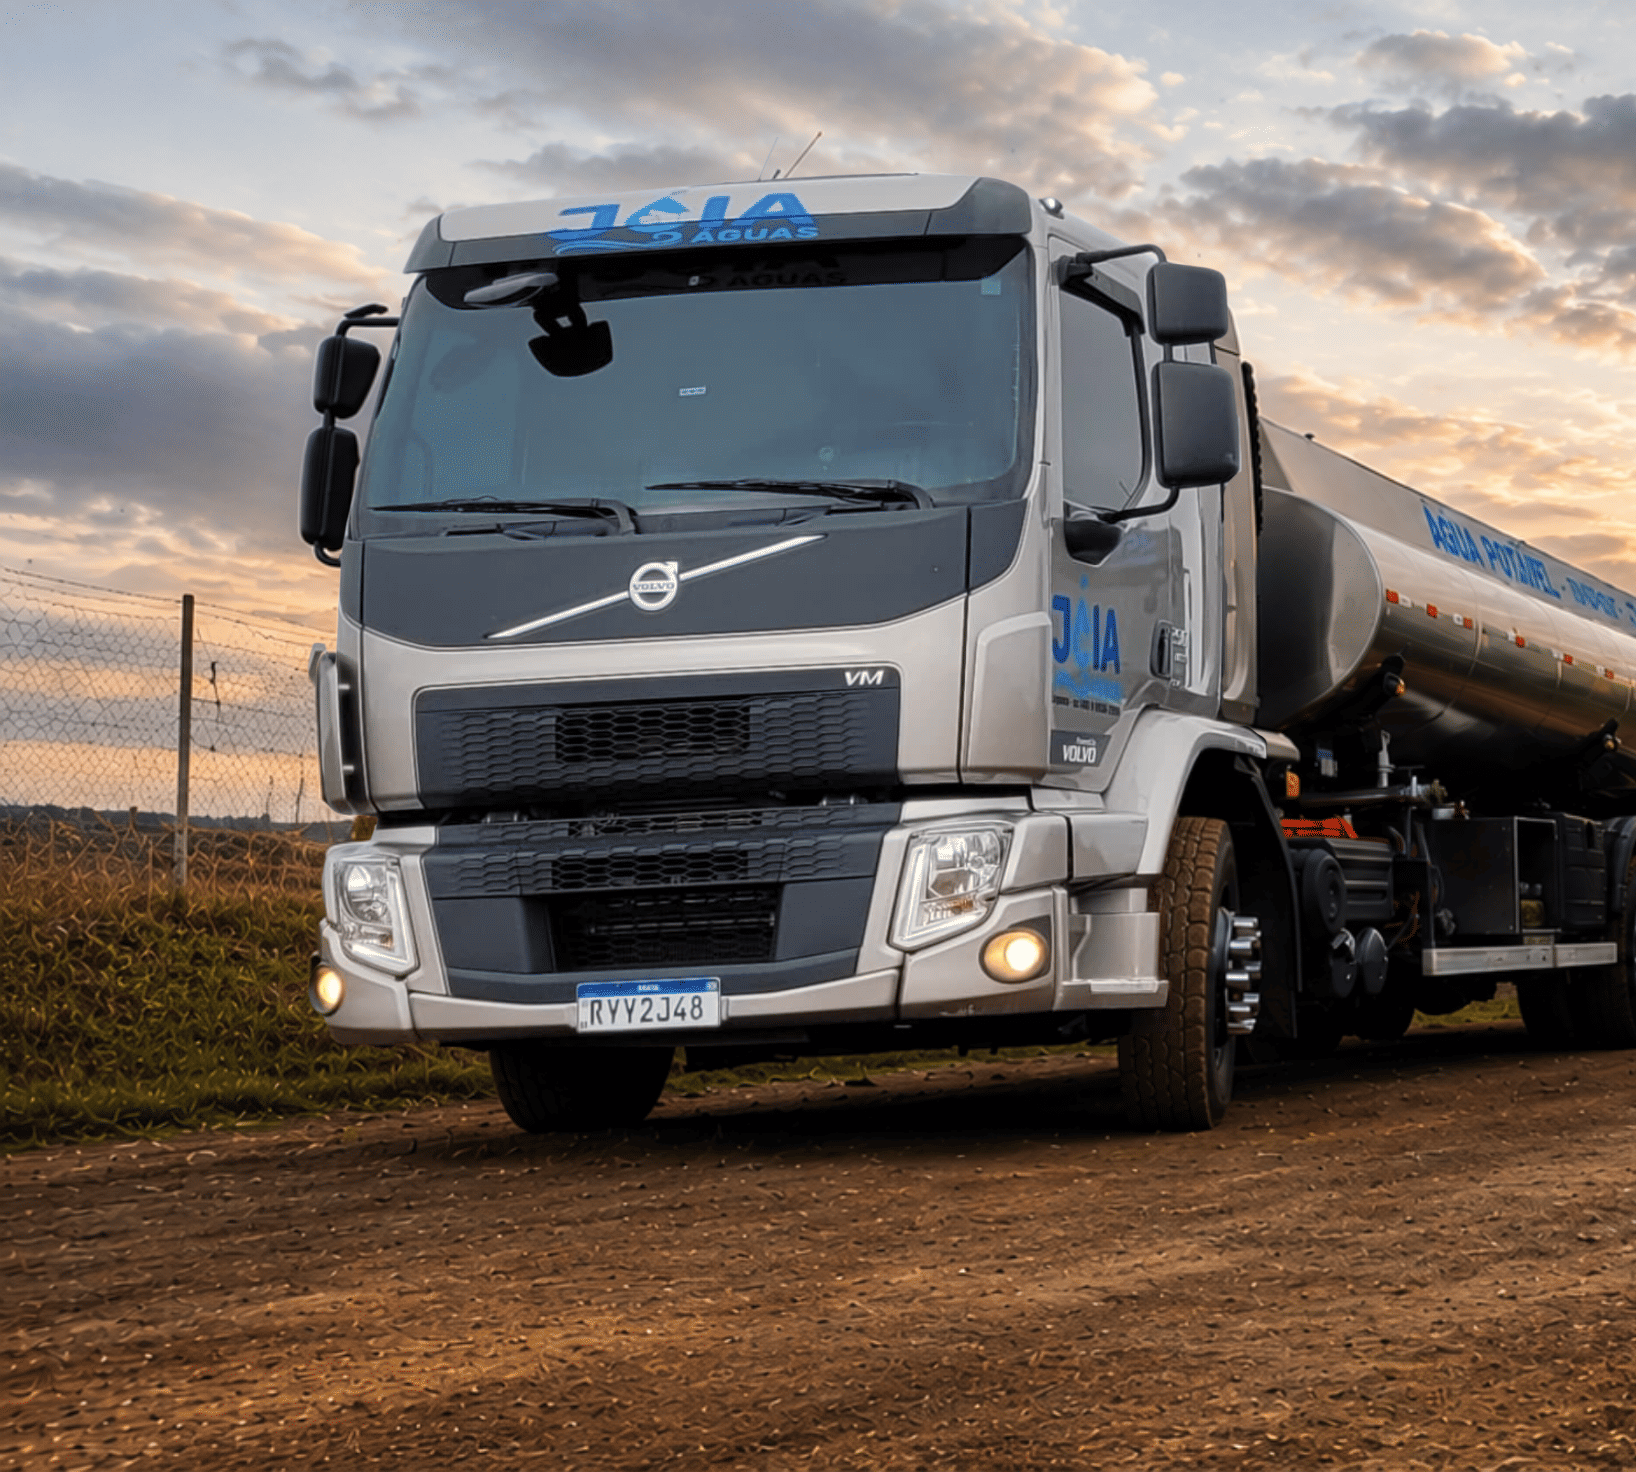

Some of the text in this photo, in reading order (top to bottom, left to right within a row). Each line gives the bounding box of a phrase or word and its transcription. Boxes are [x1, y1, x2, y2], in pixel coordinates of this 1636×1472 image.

[632, 582, 676, 591] VOLVO
[843, 670, 885, 686] VM
[1062, 744, 1097, 764] VOLVO
[590, 995, 704, 1026] RYY2J48
